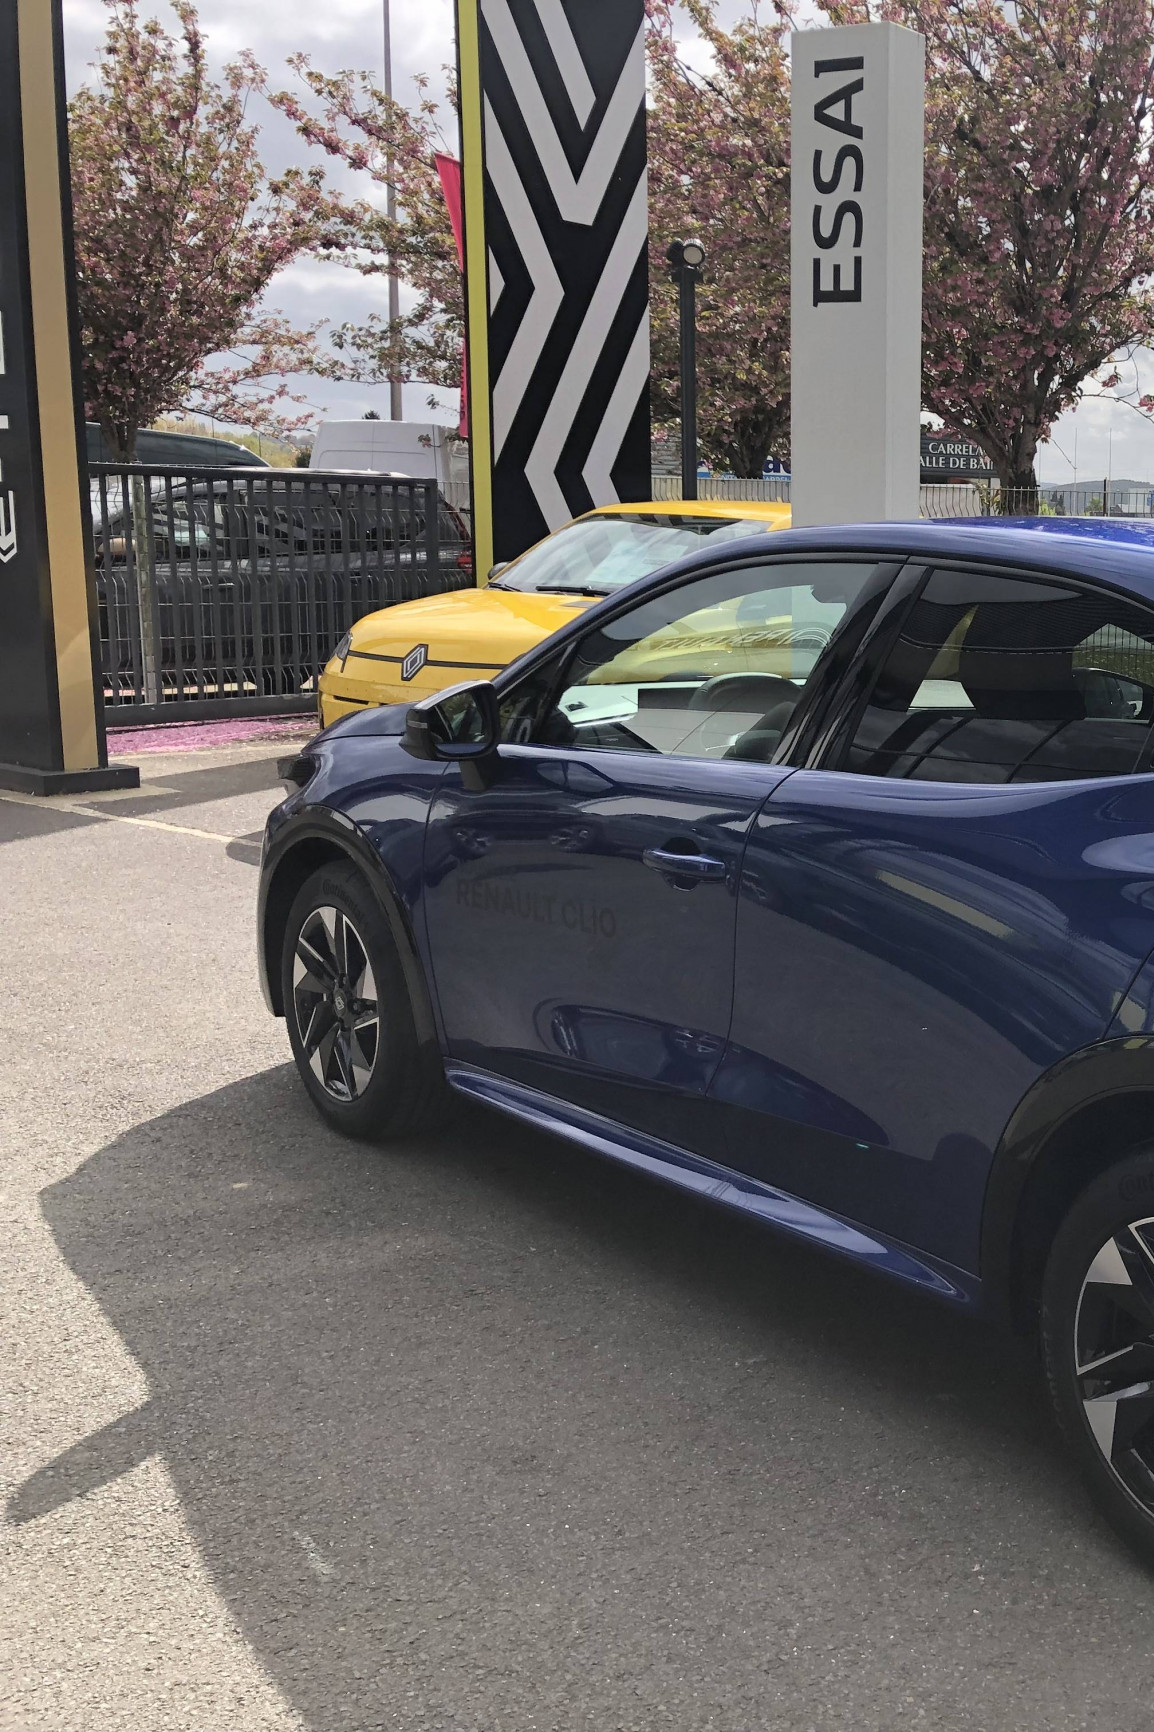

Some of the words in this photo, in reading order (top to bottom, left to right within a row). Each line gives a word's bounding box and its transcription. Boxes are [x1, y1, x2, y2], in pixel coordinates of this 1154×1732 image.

[813, 56, 864, 306] ESSAI
[920, 456, 945, 468] ALLE
[950, 457, 966, 469] DE
[970, 458, 993, 470] BAI
[929, 442, 985, 456] CARRELA
[456, 878, 557, 926] RENAULT
[562, 899, 617, 938] CLIO
